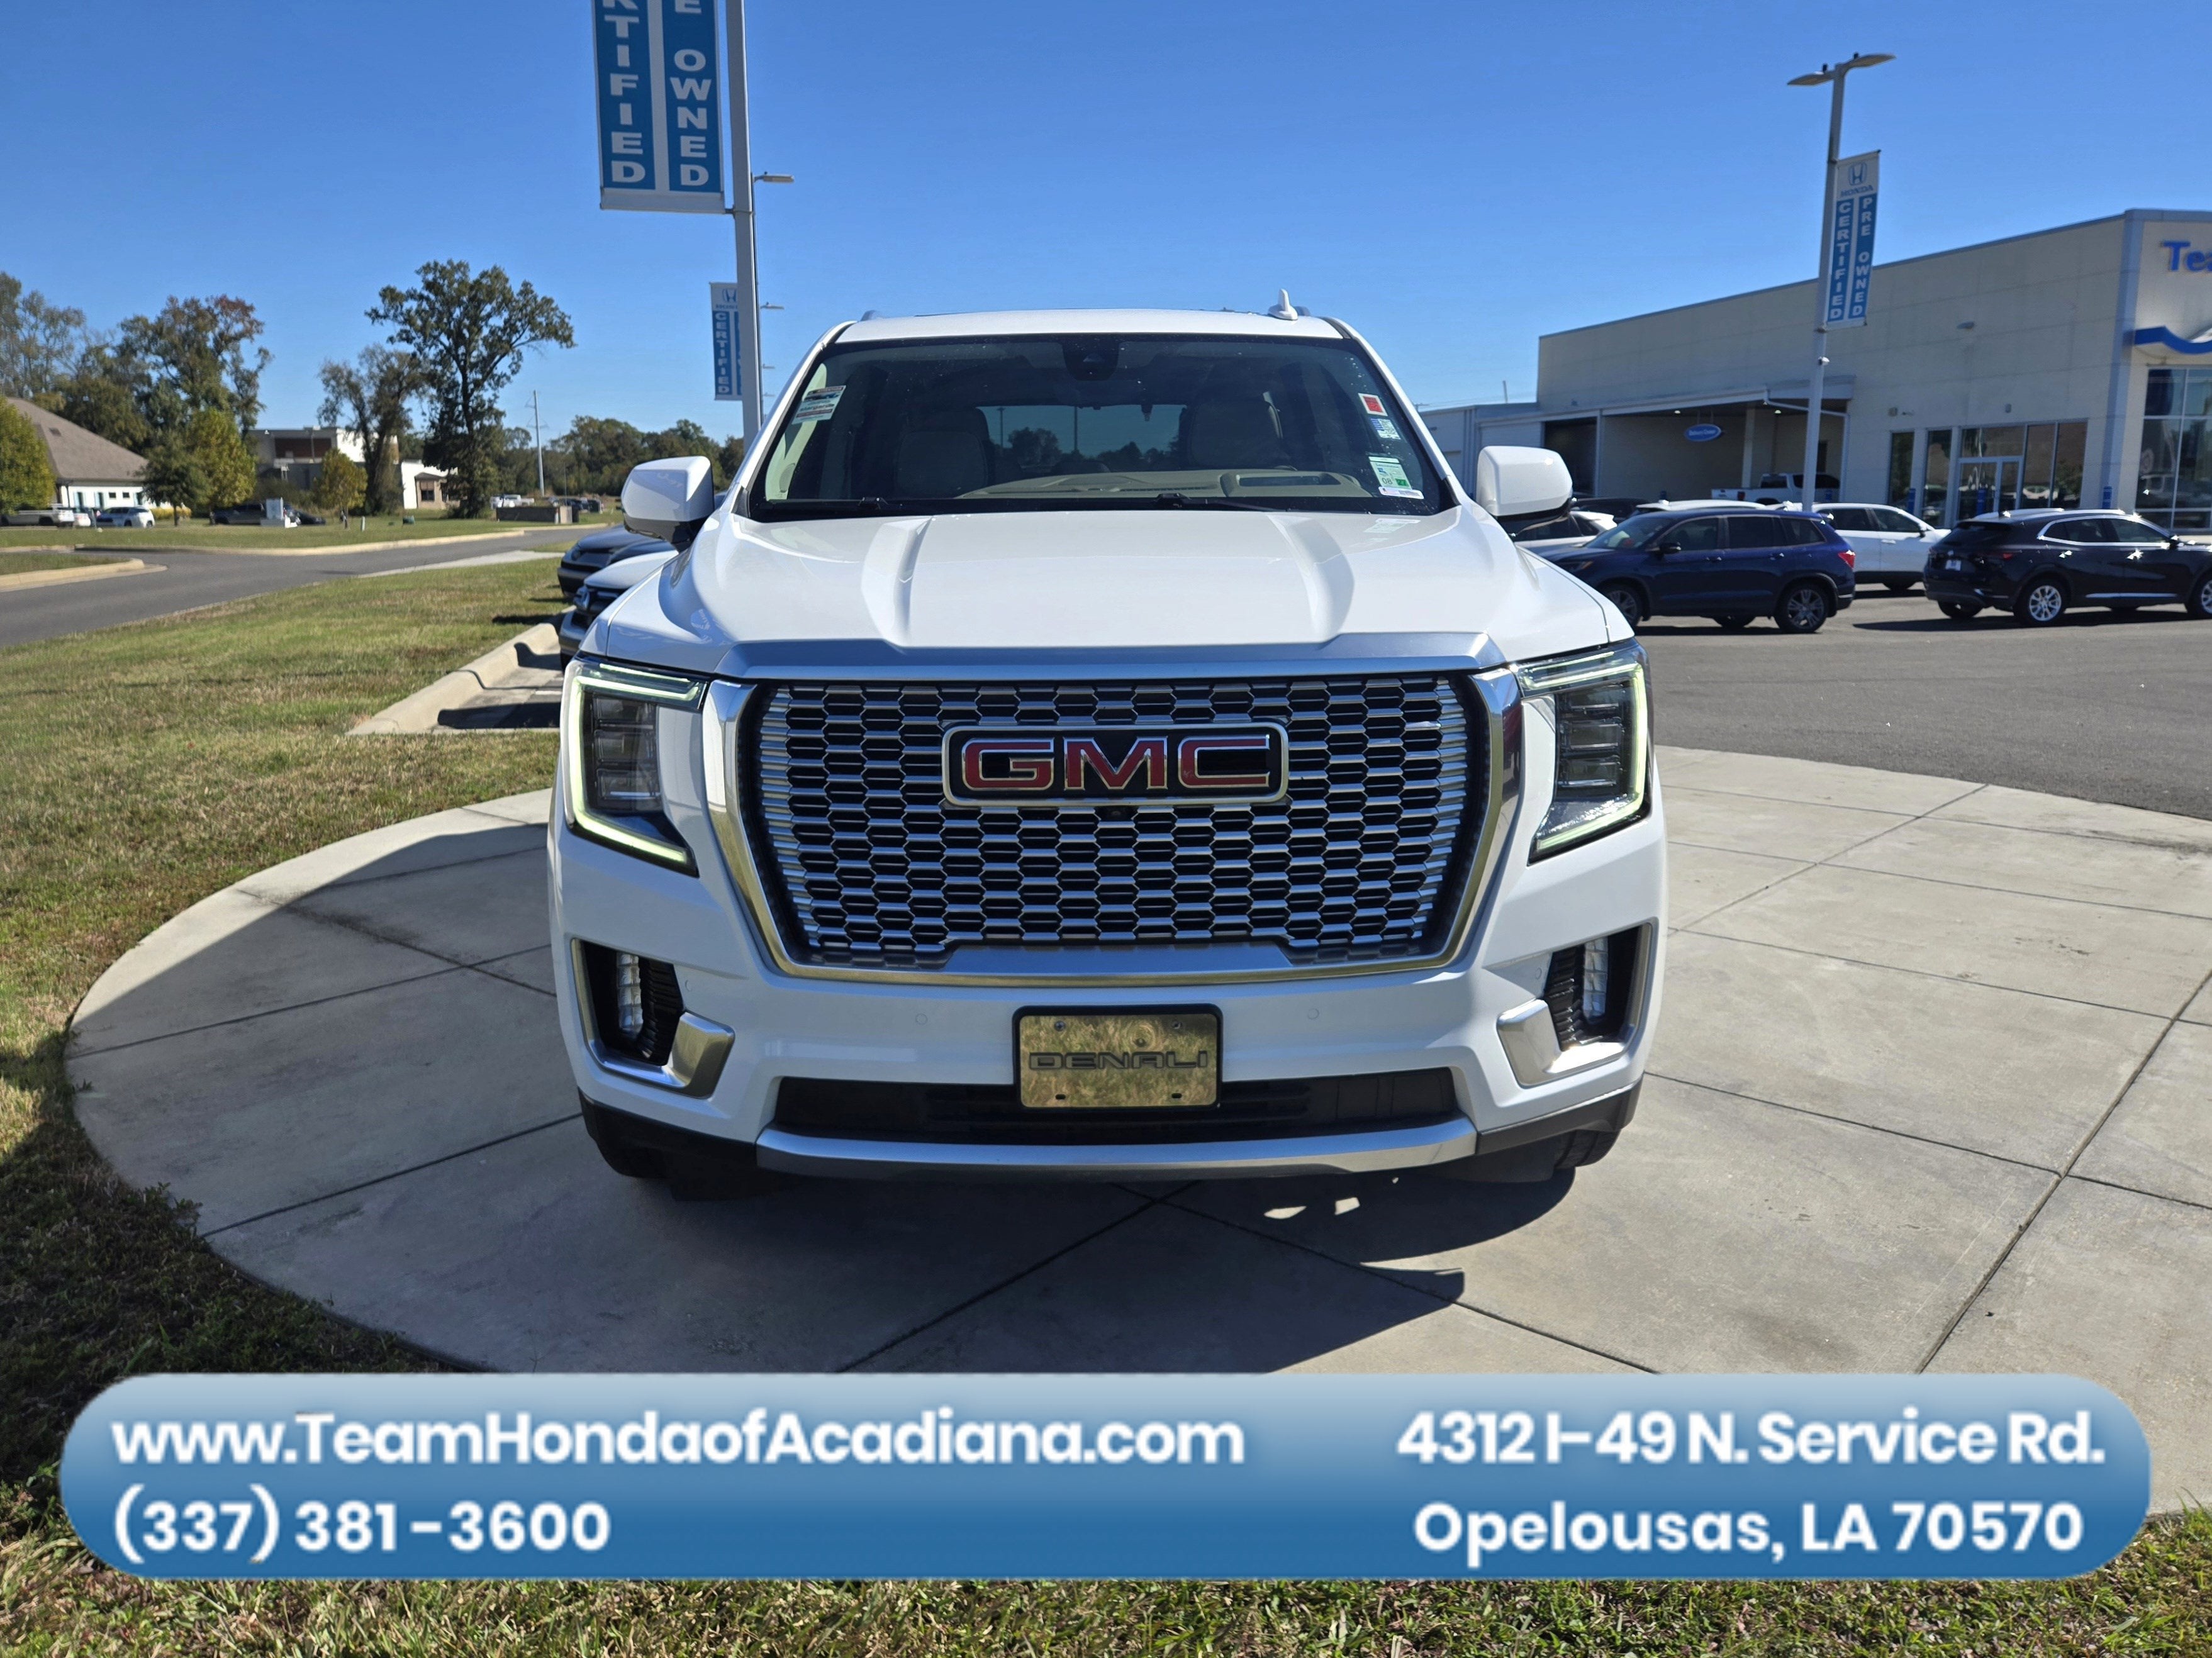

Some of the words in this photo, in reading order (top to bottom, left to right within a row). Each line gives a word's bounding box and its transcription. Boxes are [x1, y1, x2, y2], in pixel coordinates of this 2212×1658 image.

[670, 48, 712, 186] OWNED
[1861, 197, 1873, 236] PRE
[1830, 202, 1851, 320] CERTIFIED
[1852, 252, 1870, 316] OWNED
[715, 313, 730, 394] CERTIFIED
[962, 735, 1270, 791] GMC
[1029, 1050, 1208, 1070] DENALI
